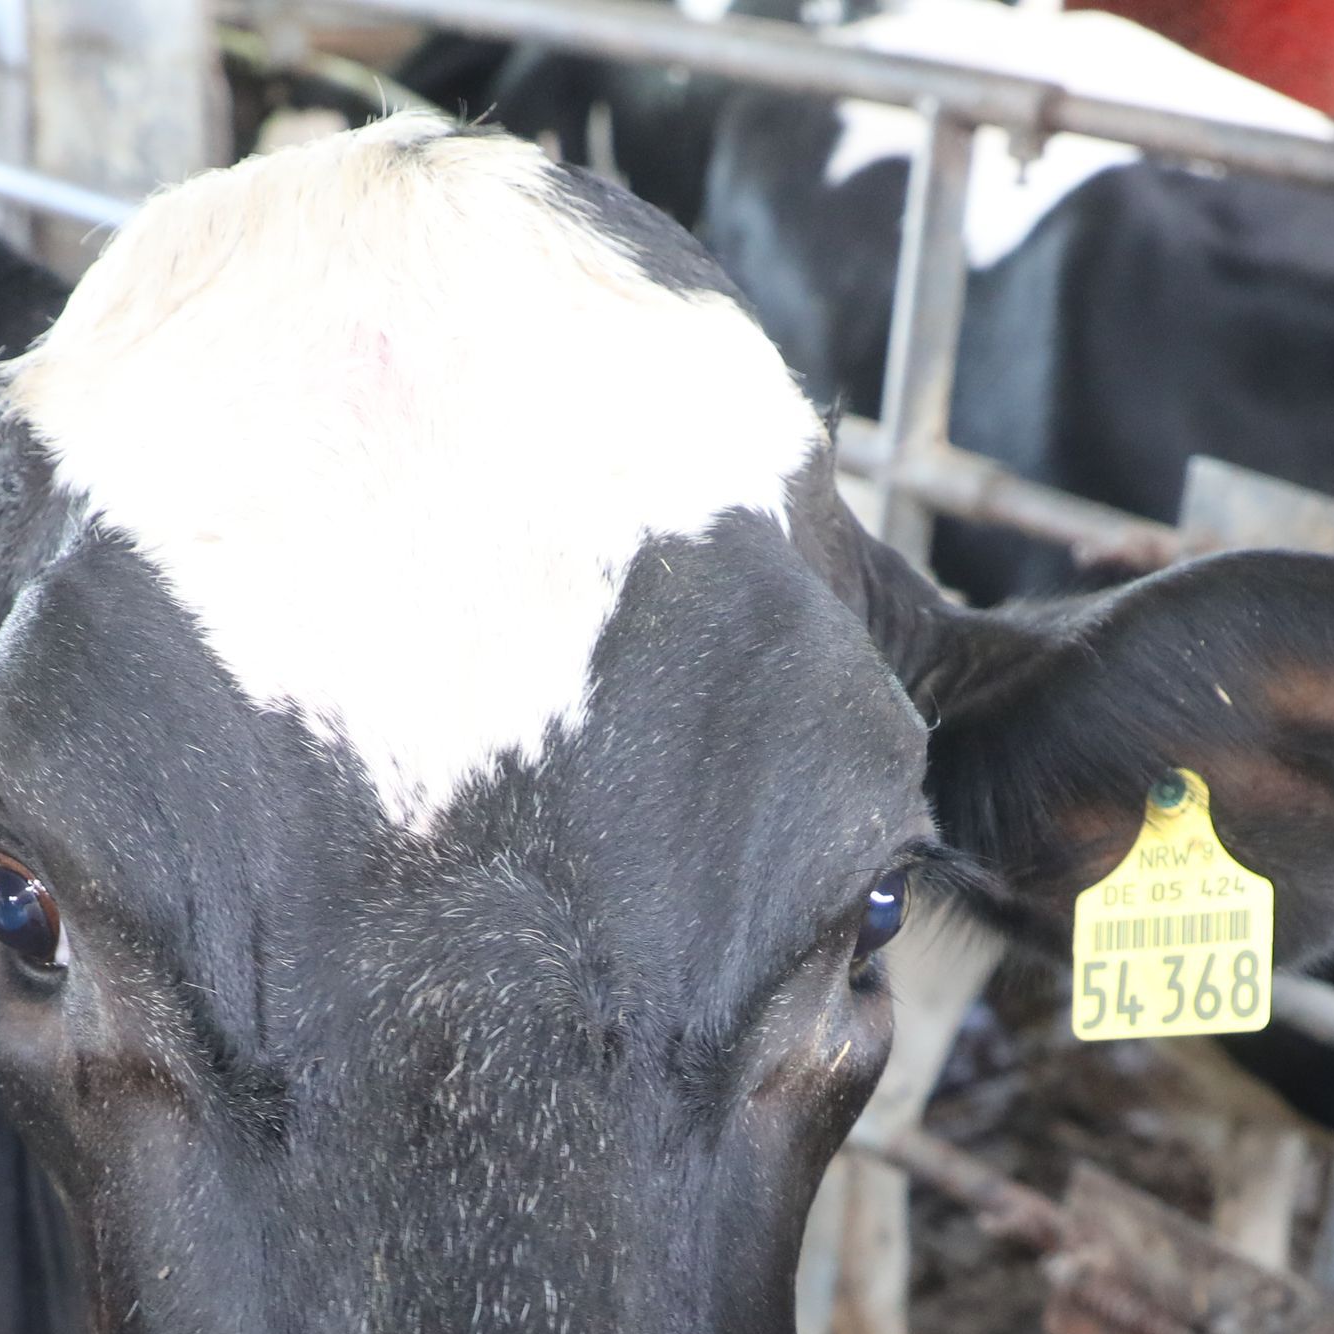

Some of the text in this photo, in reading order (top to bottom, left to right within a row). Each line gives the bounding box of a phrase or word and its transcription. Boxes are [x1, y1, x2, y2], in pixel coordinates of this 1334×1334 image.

[1139, 842, 1193, 870] NRW
[1104, 875, 1246, 906] DE 05 424
